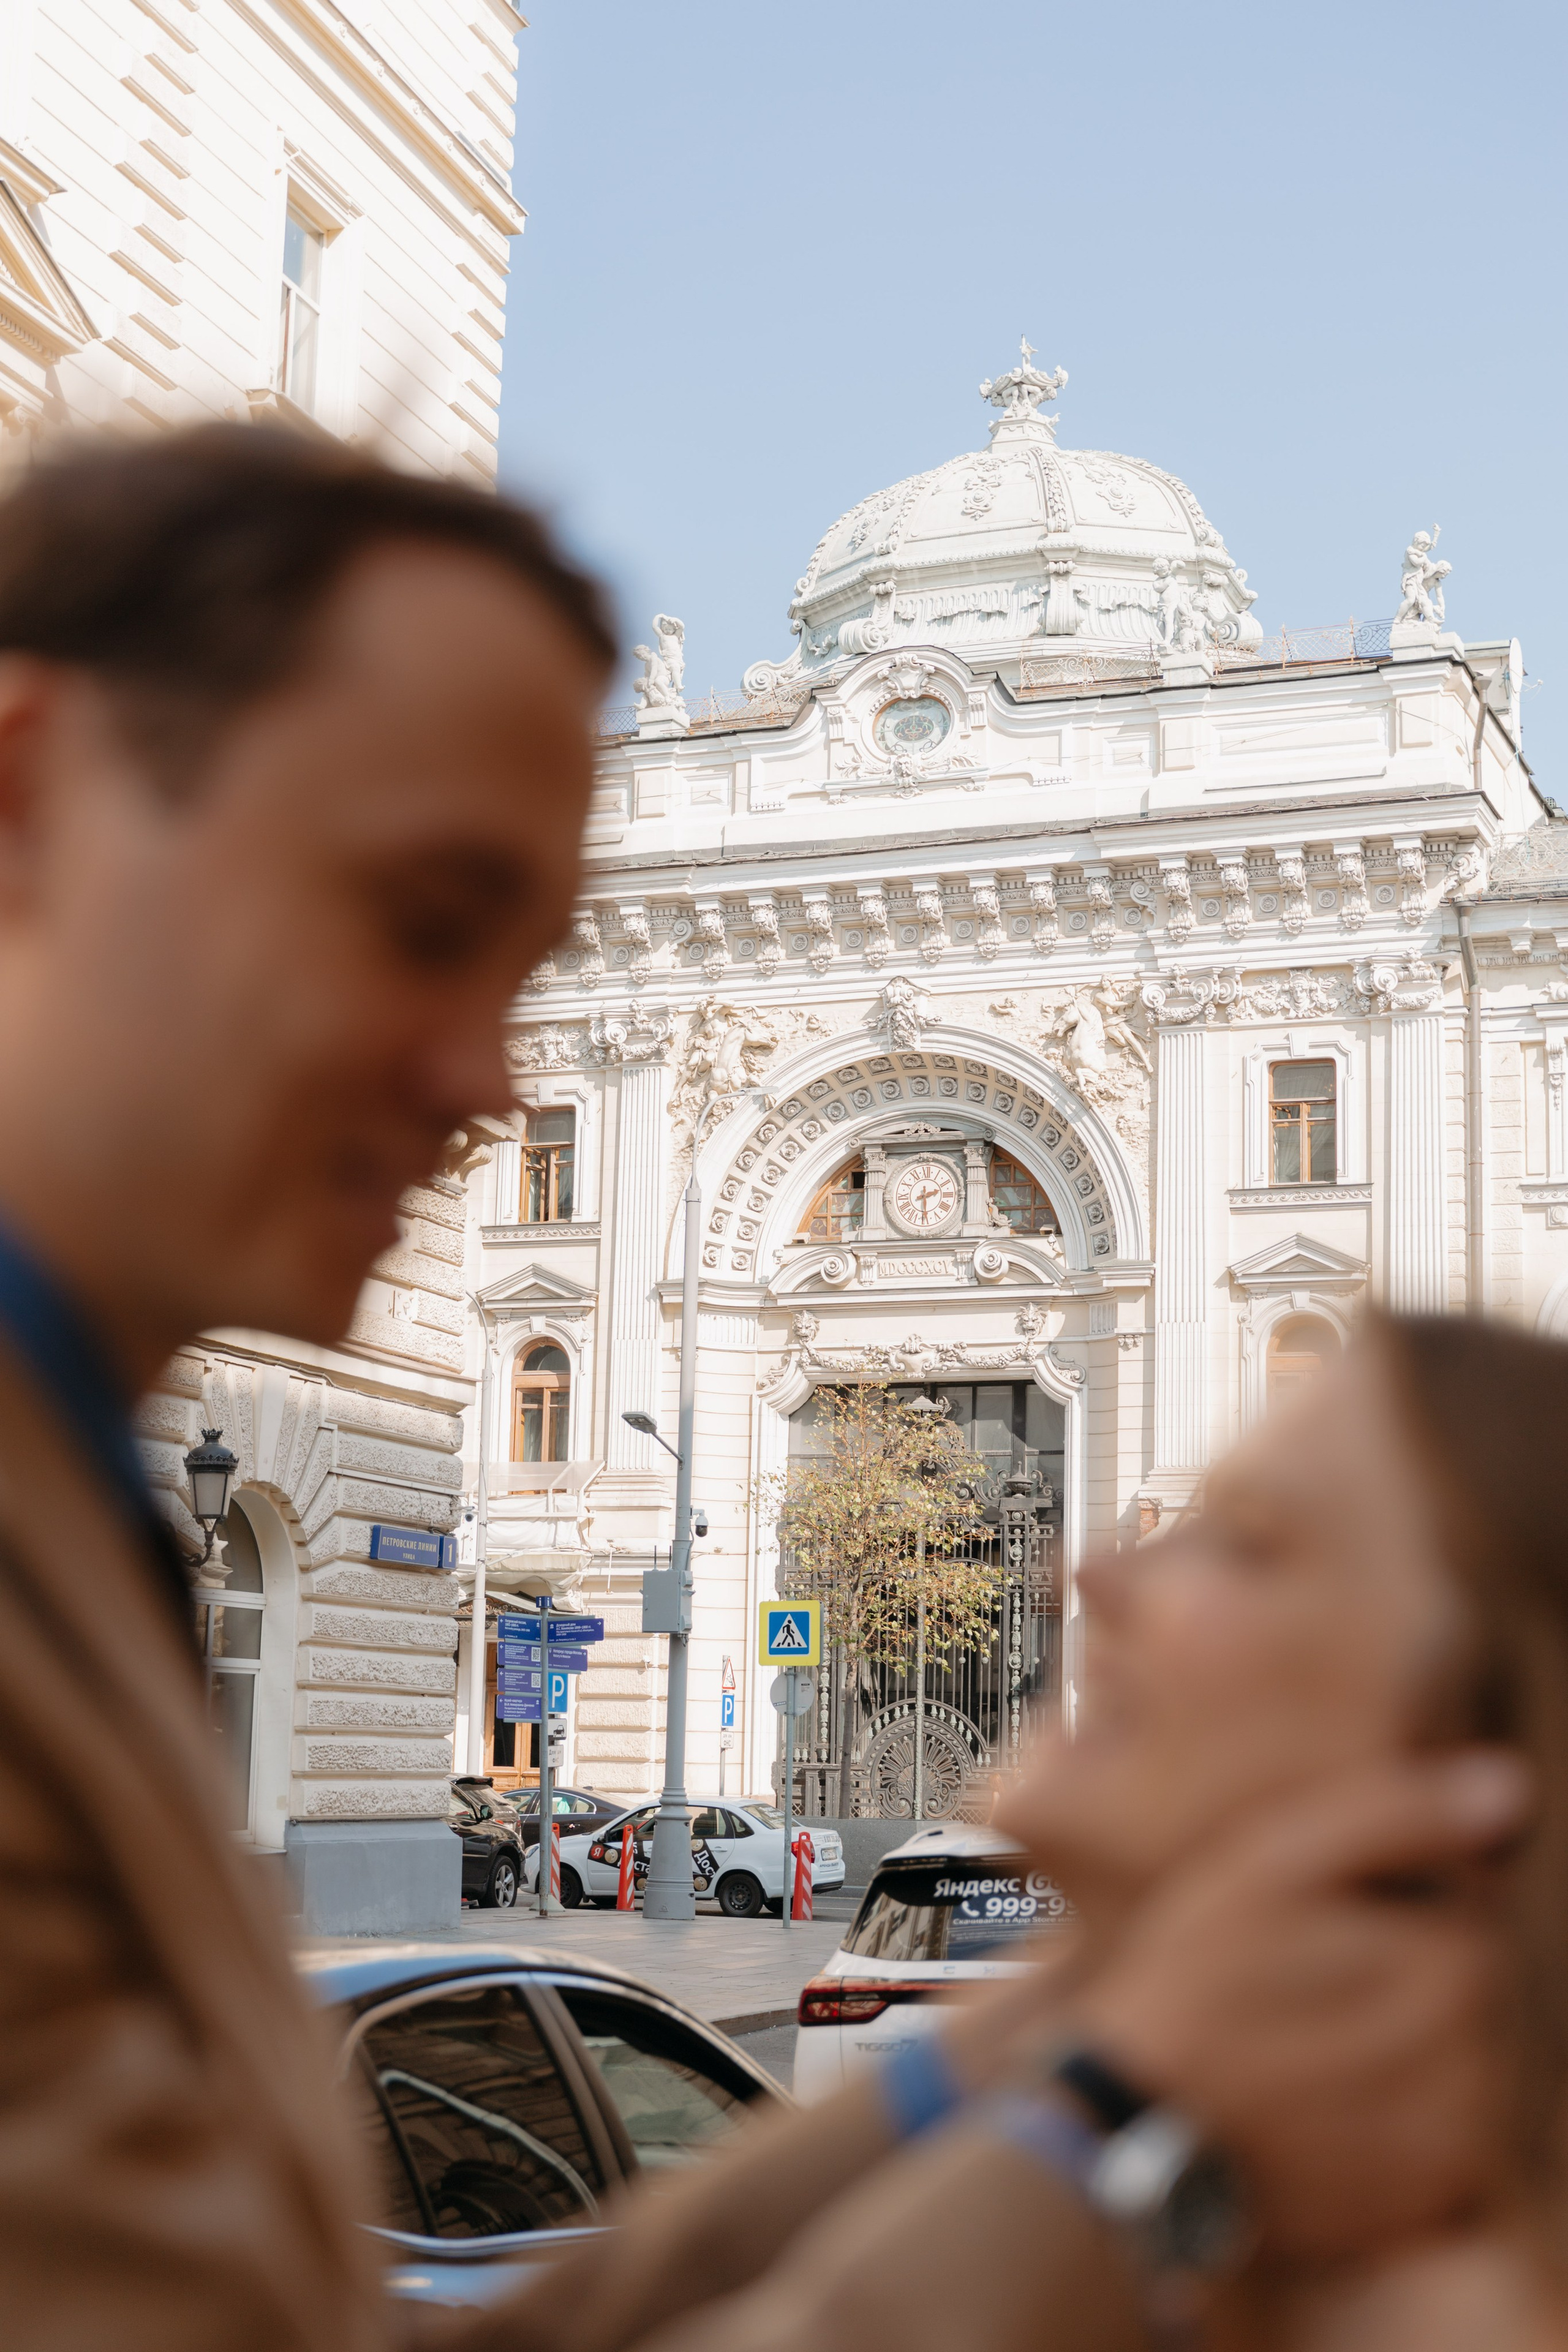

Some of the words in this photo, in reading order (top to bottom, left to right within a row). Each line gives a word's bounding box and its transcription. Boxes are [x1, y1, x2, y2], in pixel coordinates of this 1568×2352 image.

[922, 1166, 930, 1178] XII
[382, 1536, 417, 1550] ПЕТРОВСКИЕ
[418, 1542, 437, 1552] ЛИНИИ
[448, 1544, 453, 1562] 1
[552, 1675, 565, 1708] P
[724, 1697, 733, 1723] P
[594, 1847, 601, 1856] Я
[933, 1877, 1021, 1898] Яндекс
